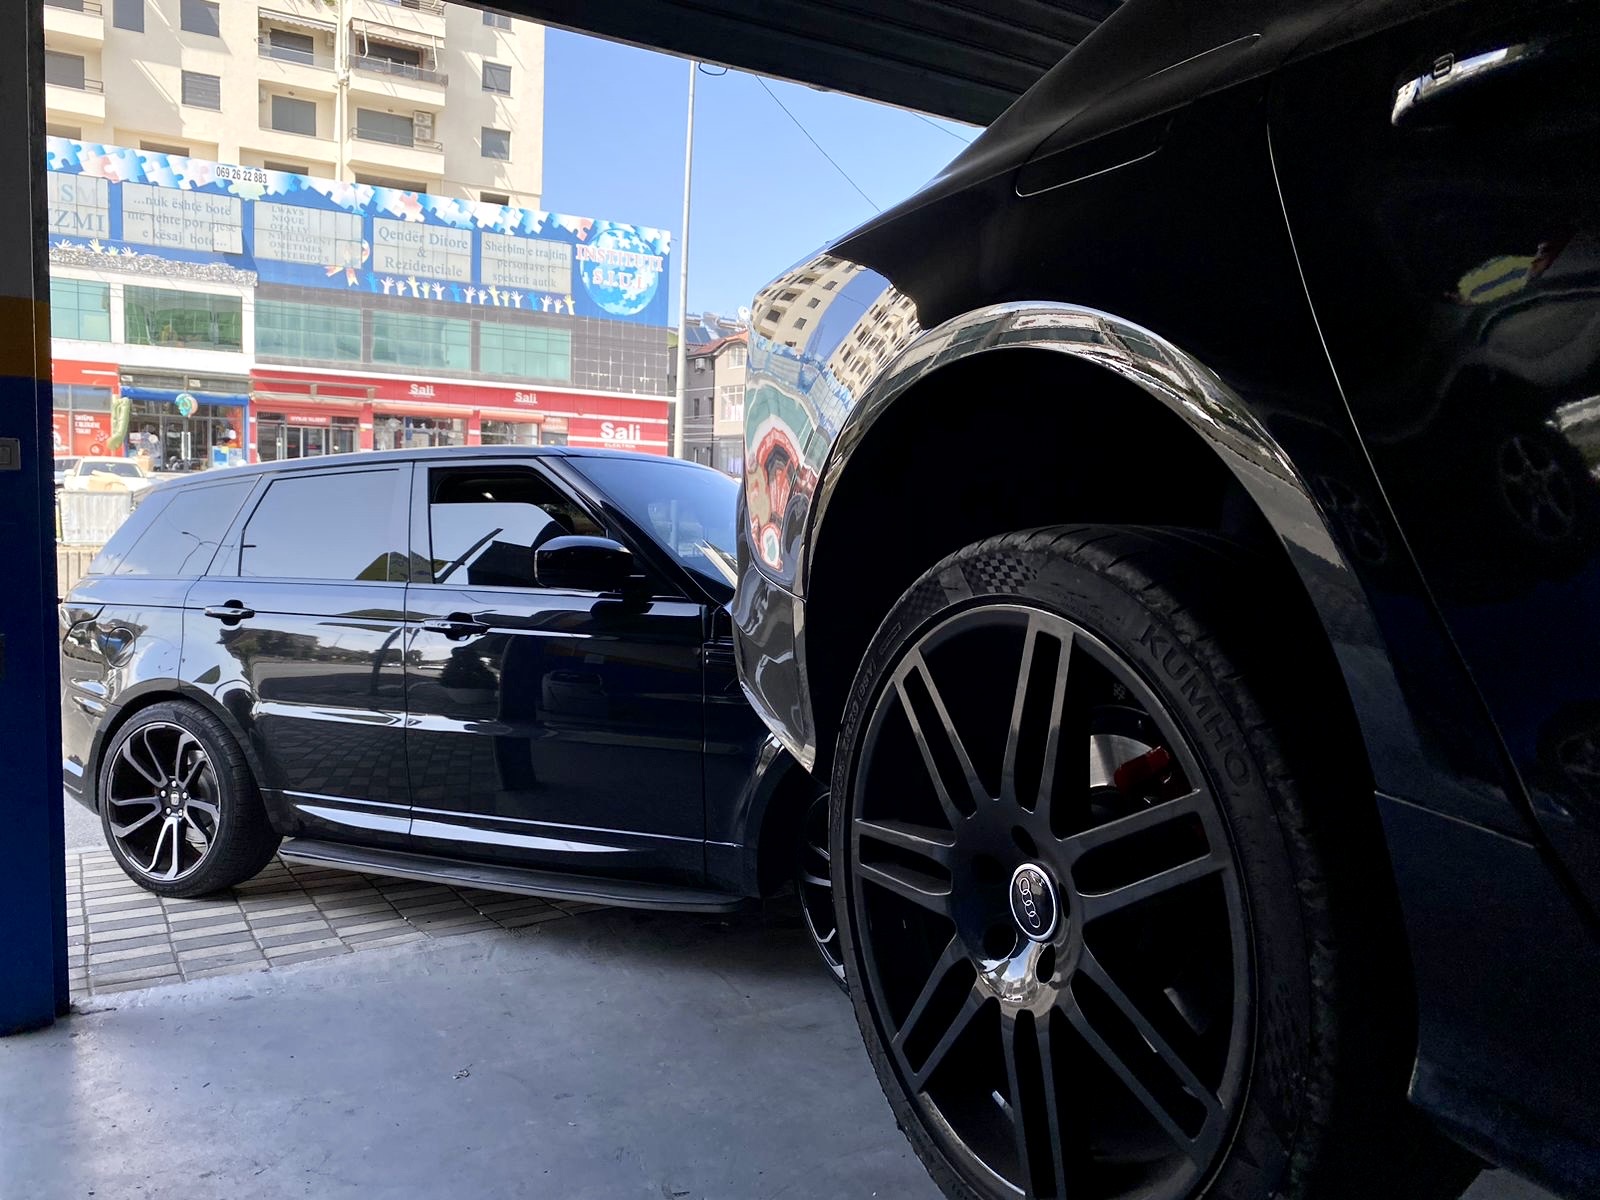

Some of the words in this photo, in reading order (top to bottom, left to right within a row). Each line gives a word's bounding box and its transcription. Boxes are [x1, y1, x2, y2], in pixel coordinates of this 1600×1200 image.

[216, 166, 230, 178] 069
[232, 168, 241, 180] 26
[243, 170, 252, 182] 22
[254, 172, 267, 184] 883
[49, 208, 105, 232] ZMI
[429, 233, 468, 249] Ditore
[417, 246, 426, 258] &
[384, 256, 462, 276] Rezidenciale
[410, 383, 435, 396] Sali
[514, 391, 537, 403] Sali
[600, 422, 641, 441] Sali
[1139, 623, 1250, 787] KUMHO
